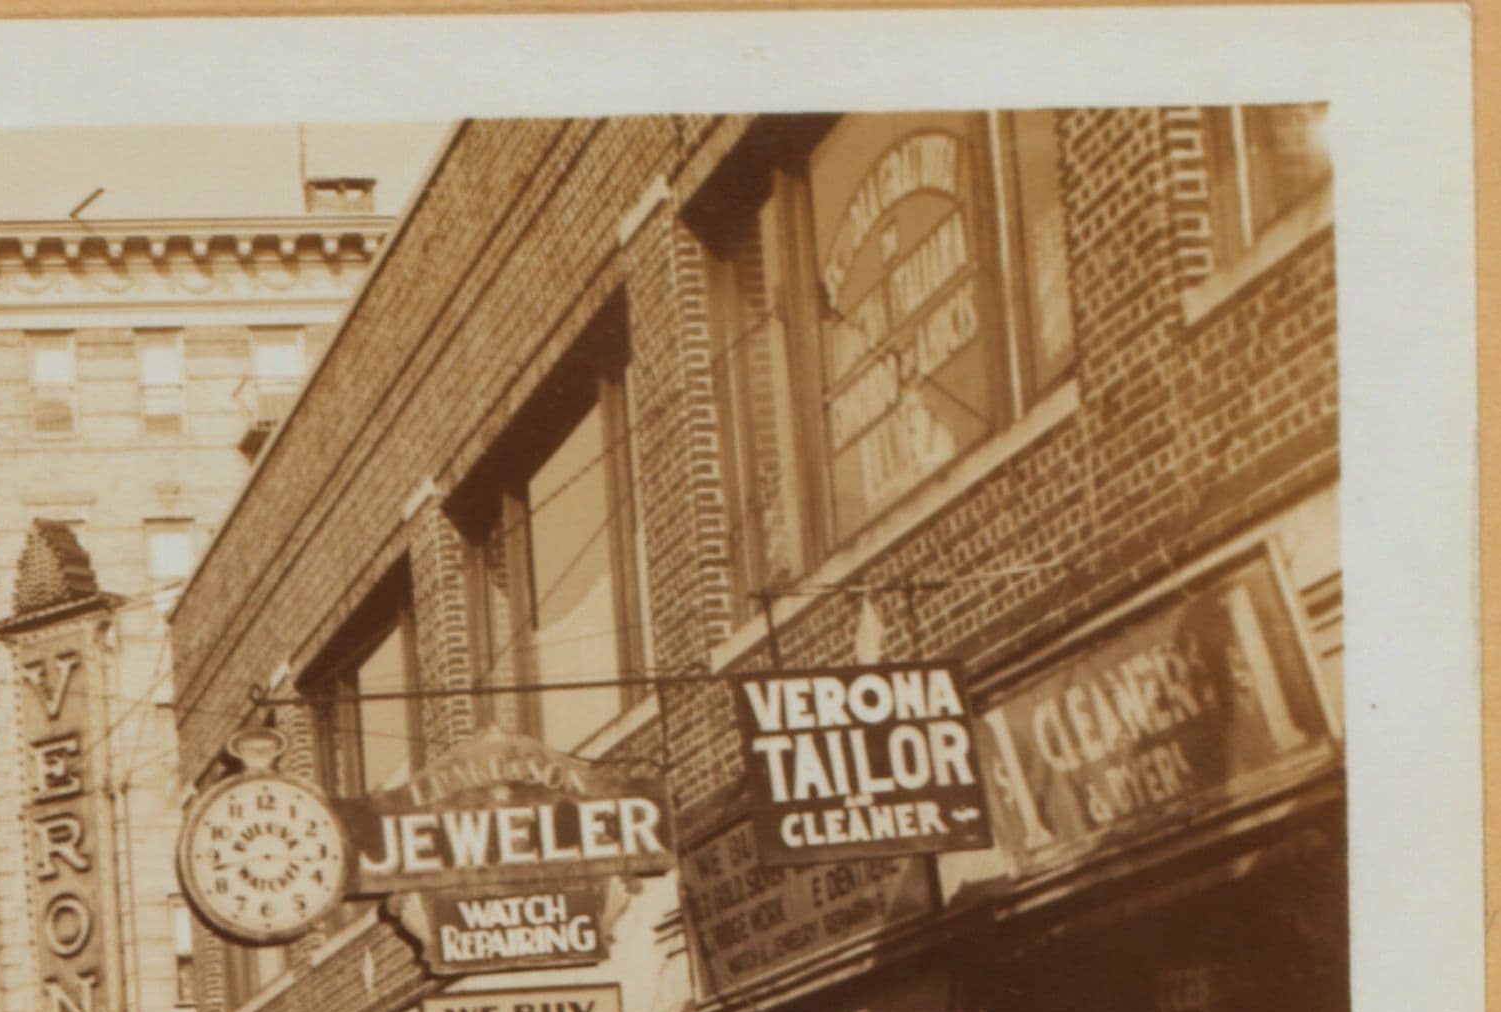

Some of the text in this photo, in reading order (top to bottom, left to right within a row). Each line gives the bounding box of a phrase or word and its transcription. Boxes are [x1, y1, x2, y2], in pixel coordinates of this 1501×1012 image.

[743, 668, 964, 732] VERONA
[751, 719, 977, 803] TAILOR
[229, 803, 243, 819] 11
[256, 794, 276, 811] 12
[289, 804, 297, 820] 1
[305, 820, 318, 839] 2
[359, 797, 668, 874] JEWELER
[780, 801, 950, 848] CLEANER
[456, 894, 569, 929] WATCH
[440, 915, 598, 963] REPAIRING
